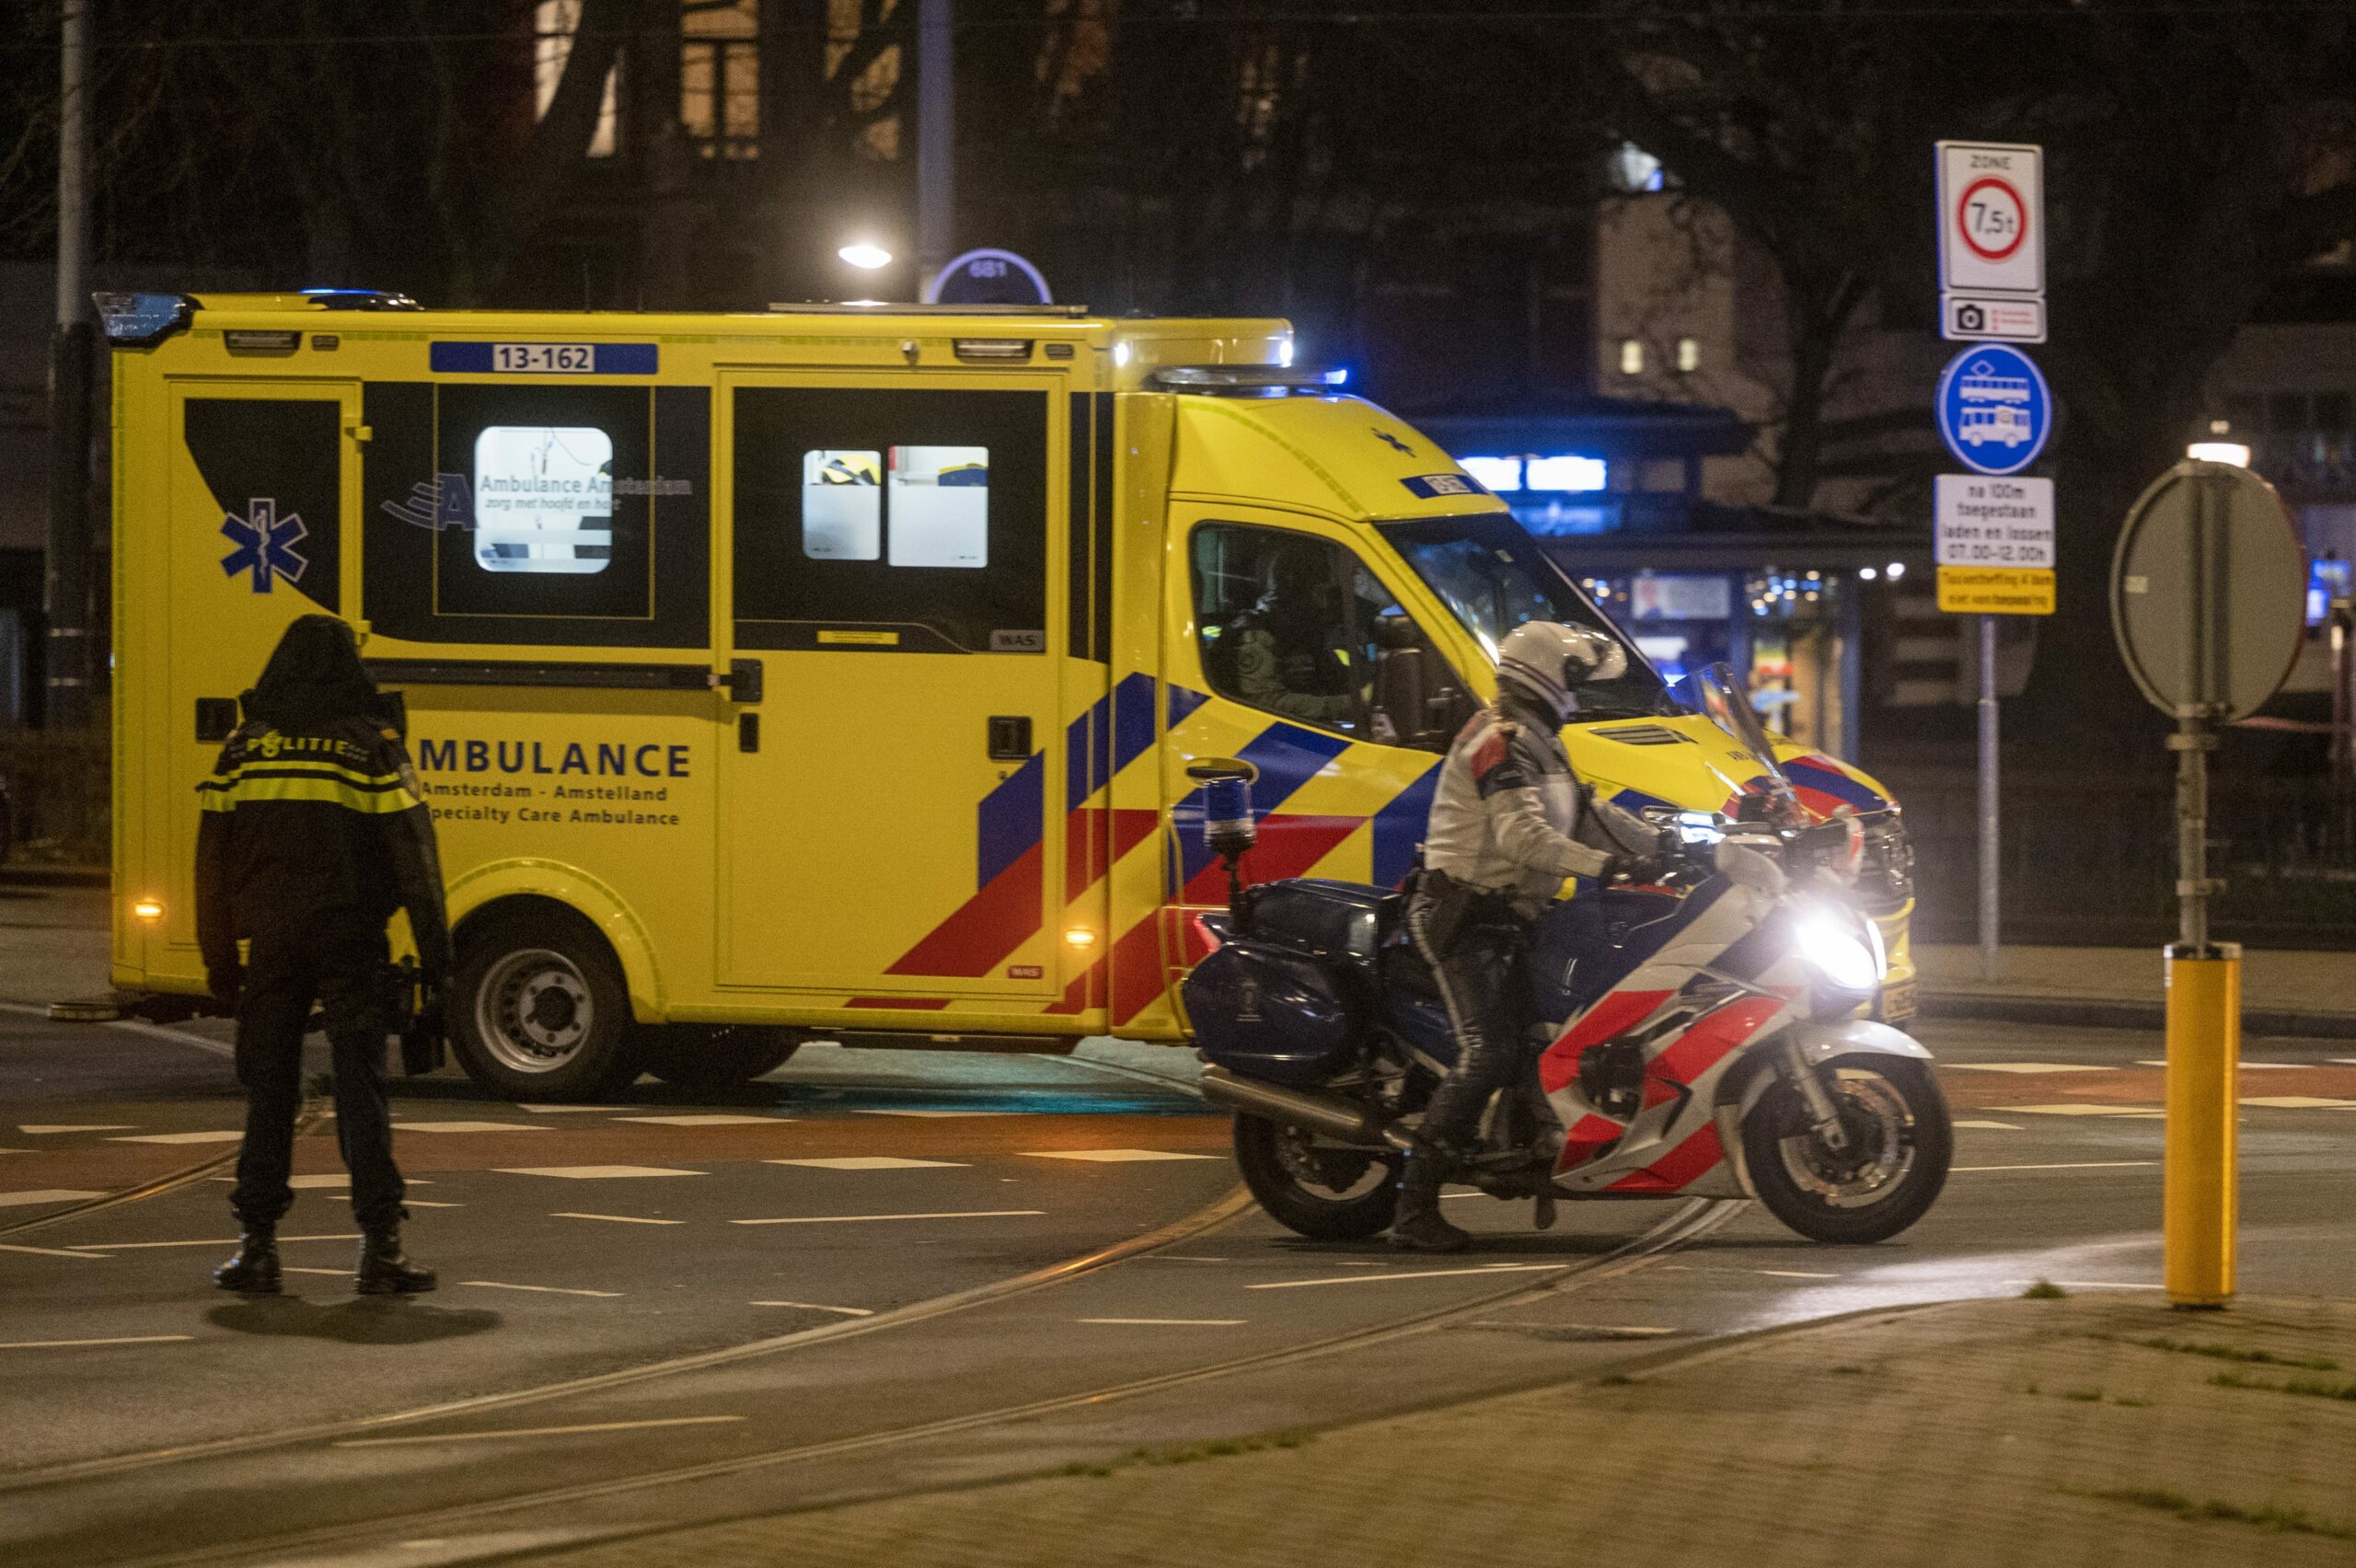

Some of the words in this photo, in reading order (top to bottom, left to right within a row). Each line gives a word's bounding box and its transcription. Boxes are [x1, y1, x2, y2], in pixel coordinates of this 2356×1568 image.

[1970, 155, 2012, 169] ZONE
[498, 346, 590, 370] 13-162
[479, 474, 583, 493] Ambulance
[586, 476, 693, 495] Amsterdam
[485, 498, 513, 512] zorg
[514, 498, 537, 510] met
[540, 497, 575, 513] hoofd
[576, 501, 592, 511] en
[1956, 502, 2038, 521] toegestaan
[1942, 525, 1981, 539] laden
[1985, 528, 2002, 539] en
[2007, 526, 2053, 541] lossen
[419, 739, 690, 778] MBULANCE
[422, 782, 532, 798] Amsterdam
[553, 785, 668, 801] Amstelland
[431, 806, 510, 824] pecialty
[517, 807, 561, 823] Care
[568, 809, 679, 825] Ambulance
